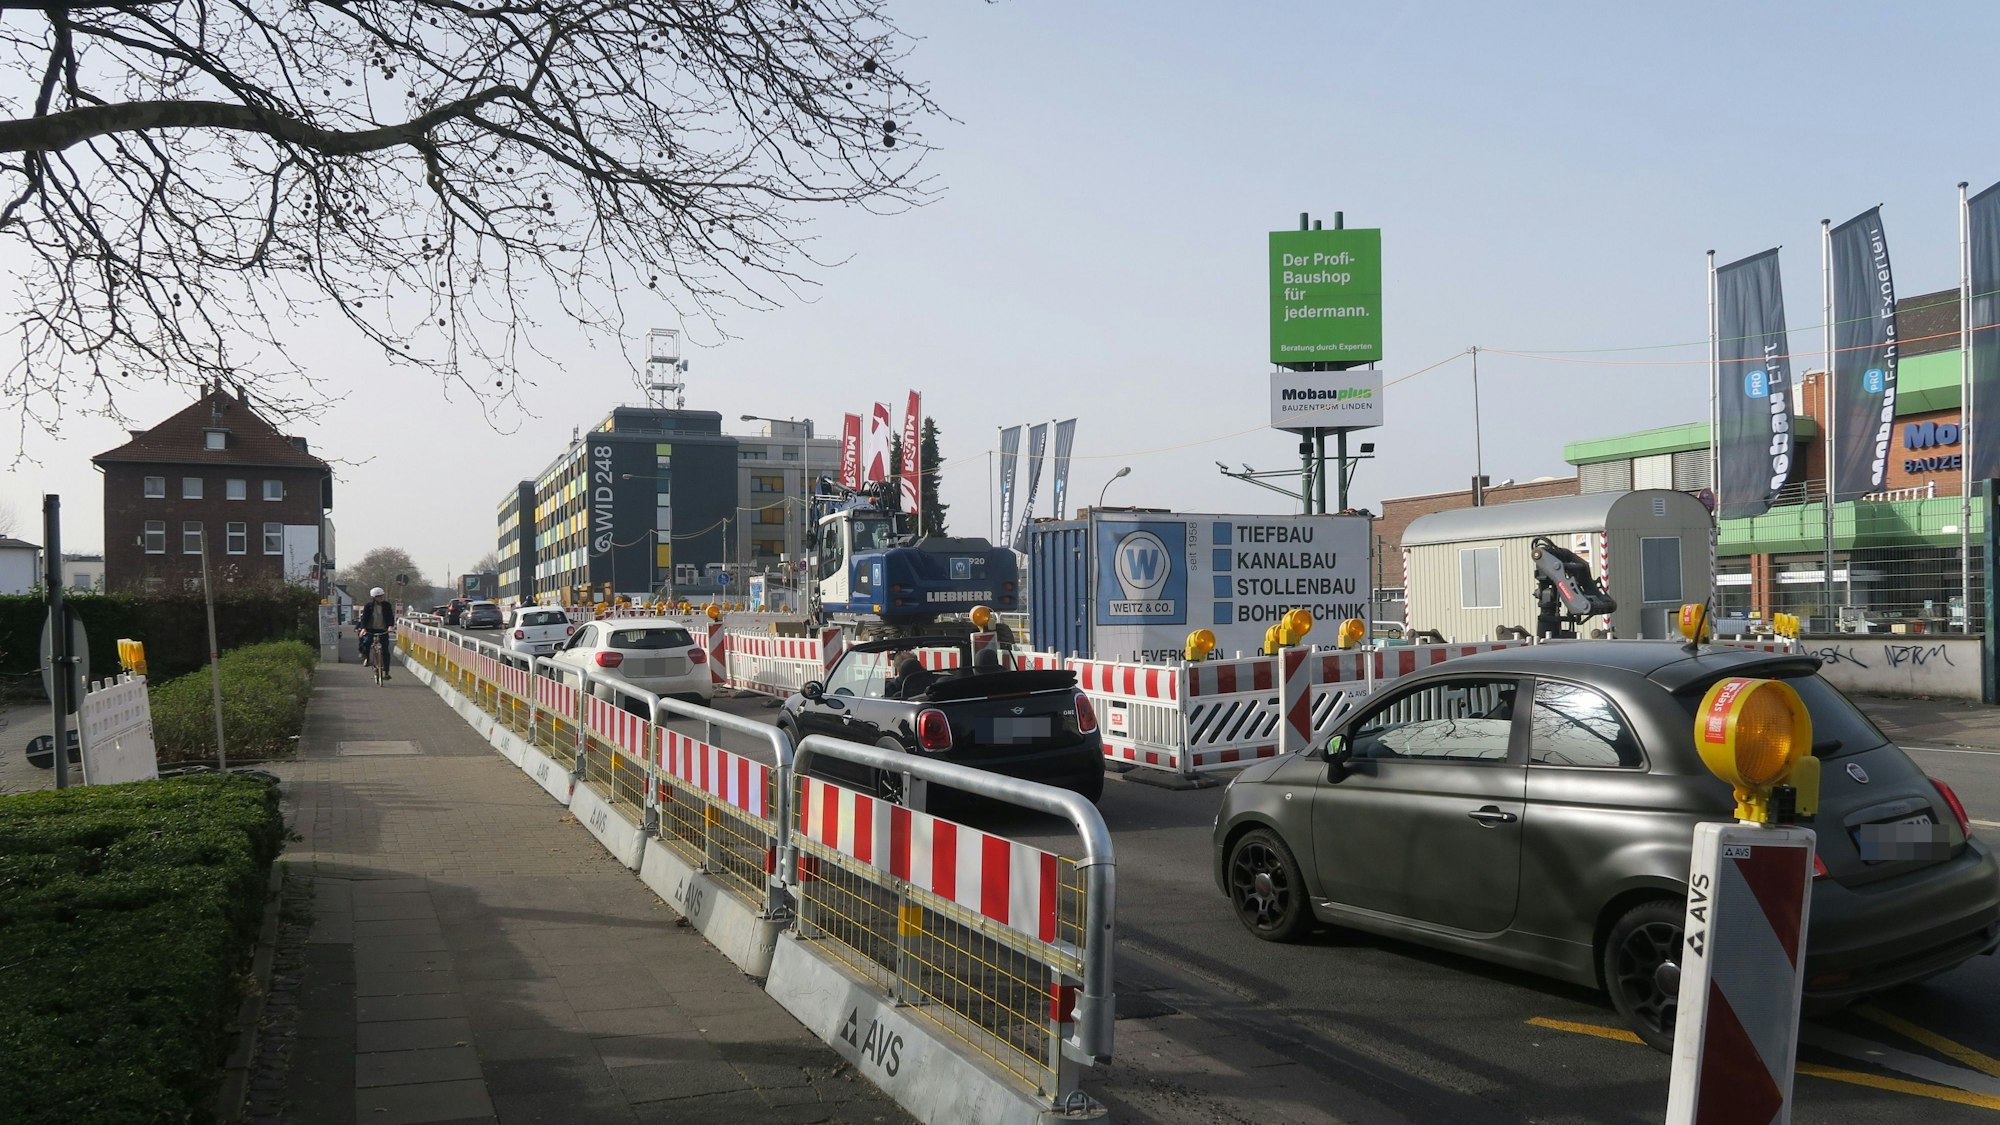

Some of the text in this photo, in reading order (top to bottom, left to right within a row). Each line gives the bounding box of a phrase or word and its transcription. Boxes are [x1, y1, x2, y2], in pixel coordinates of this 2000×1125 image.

[1283, 252, 1355, 267] Der Profi-
[1283, 271, 1351, 286] Baushop
[1284, 287, 1306, 301] für
[1284, 305, 1370, 322] jedermann.
[1281, 344, 1315, 353] Beratung
[1339, 343, 1373, 352] Experten
[1752, 372, 1762, 395] PRO
[1870, 371, 1879, 391] PRO
[1282, 387, 1373, 402] Mobauplus
[1282, 403, 1373, 412] BAUZENTRUM LINDEN
[594, 445, 614, 532] WID 248
[1237, 525, 1313, 543] TIEFBAU
[1188, 522, 1199, 571] seit 1958
[1126, 548, 1159, 580] W
[1237, 552, 1336, 569] KANALBAU
[1237, 578, 1356, 595] STOLLENBAU
[927, 590, 993, 602] LIEBHERR
[1113, 602, 1171, 613] WEITZ & CO.
[1133, 647, 1223, 662] LEVERKEN
[1355, 690, 1367, 698] AVS
[1714, 690, 1729, 712] step
[1735, 848, 1749, 857] AVS
[684, 882, 703, 917] AVS
[1690, 873, 1709, 924] AVS
[861, 1019, 904, 1078] AVS
